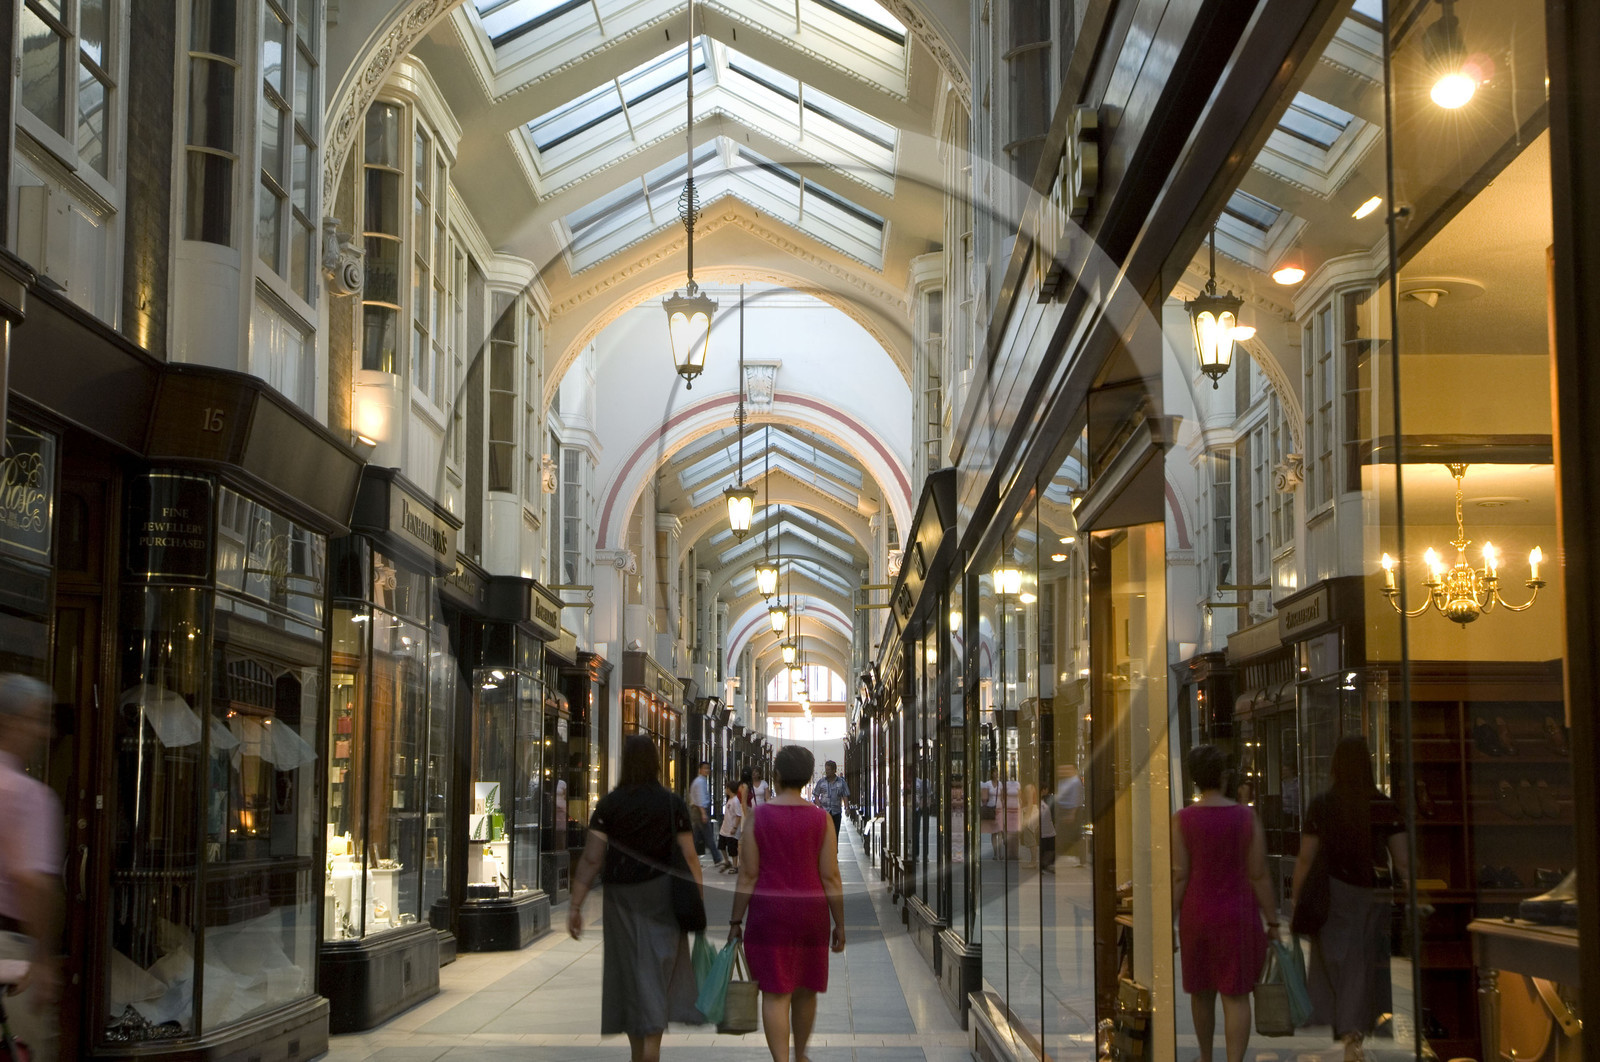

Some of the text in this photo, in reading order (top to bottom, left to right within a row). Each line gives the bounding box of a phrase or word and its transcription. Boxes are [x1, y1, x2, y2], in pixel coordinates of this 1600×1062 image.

[202, 407, 224, 432] 15
[162, 507, 189, 519] FINE
[141, 521, 203, 535] JEWELLERY
[139, 536, 205, 549] PURCHASED
